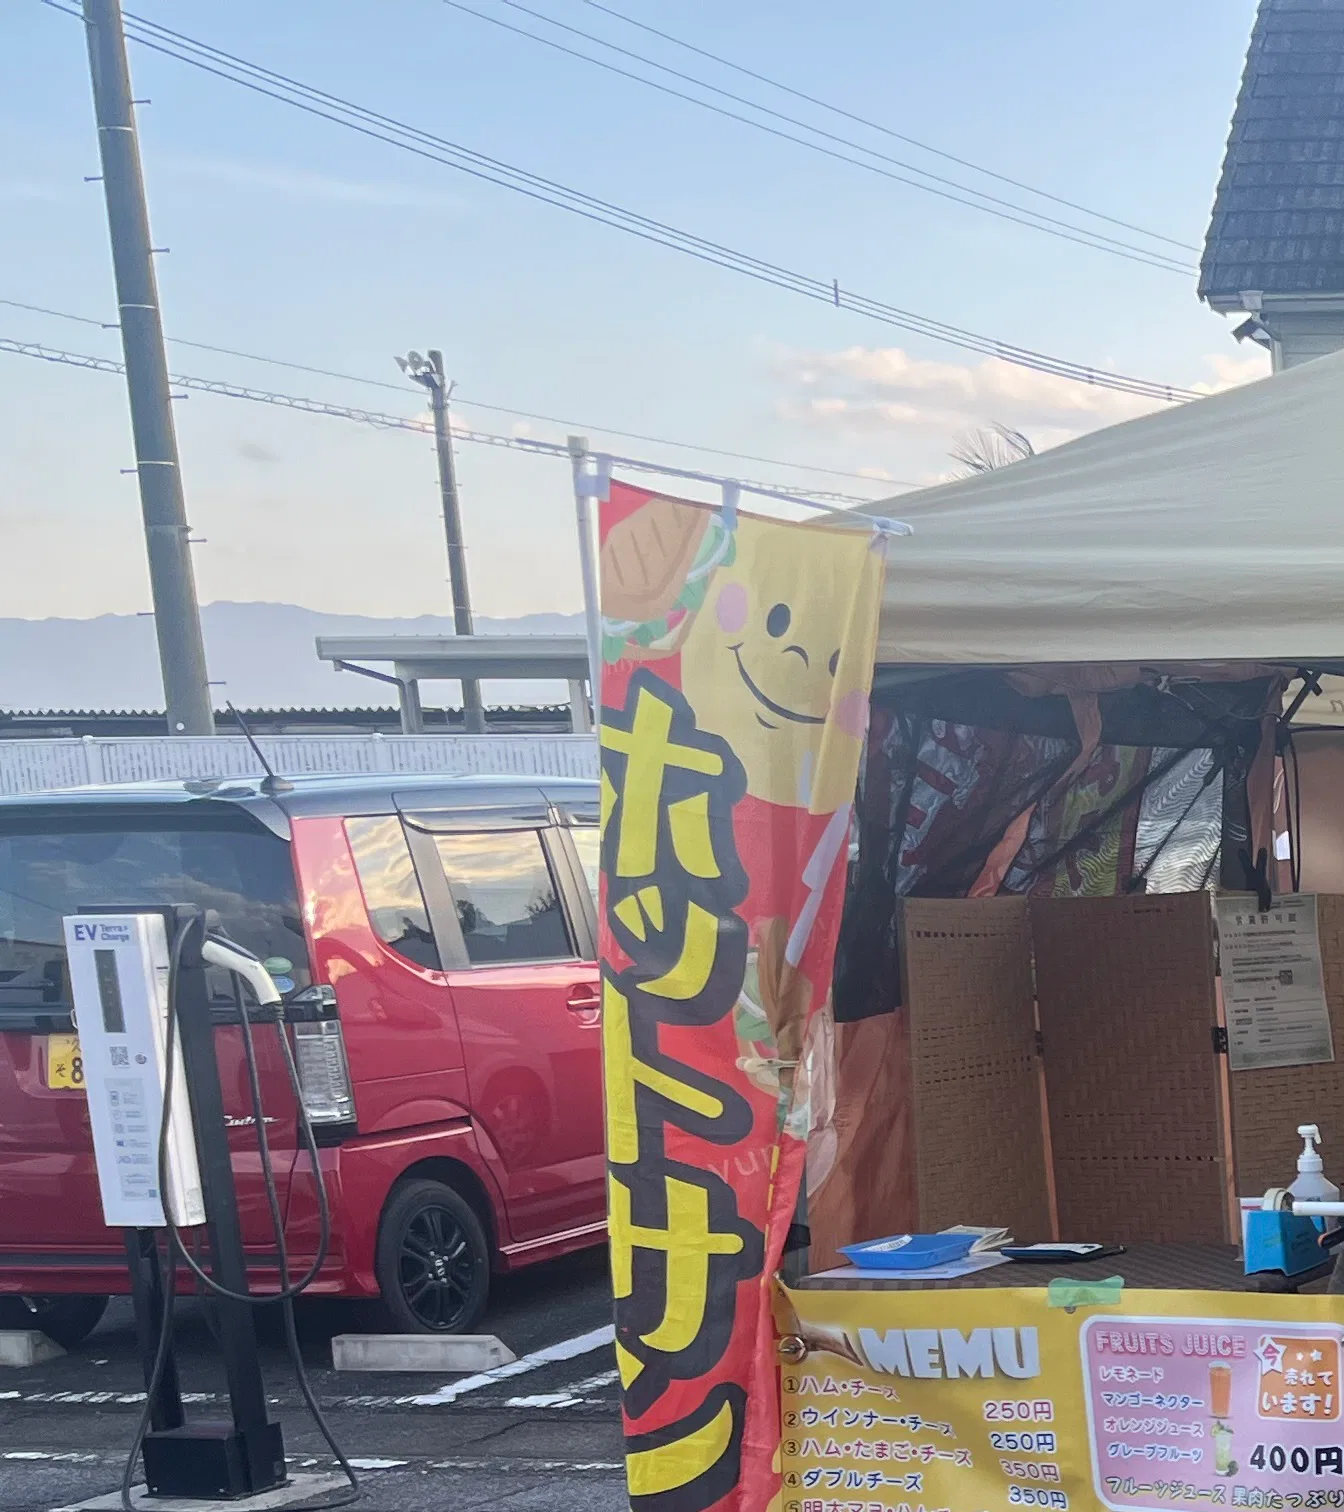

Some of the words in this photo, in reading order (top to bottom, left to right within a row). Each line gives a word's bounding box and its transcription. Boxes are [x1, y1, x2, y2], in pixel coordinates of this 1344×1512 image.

[74, 924, 97, 941] EV
[857, 1325, 1041, 1379] MEMU
[1094, 1330, 1175, 1357] FRUITS
[1183, 1333, 1247, 1359] JUICE
[1262, 1346, 1281, 1367] 今
[1100, 1366, 1164, 1384] レモネード
[1284, 1369, 1334, 1387] 売れて
[985, 1402, 1053, 1422] 250円
[1102, 1392, 1204, 1411] マンゴーネクター
[1262, 1392, 1334, 1415] います!
[1105, 1418, 1204, 1437] オレンジジュース
[991, 1432, 1056, 1453] 250円
[1108, 1444, 1204, 1461] グレープフルーツ
[802, 1439, 973, 1467] ハム・たまご・チーズ
[1001, 1459, 1060, 1482] 350円
[1250, 1444, 1344, 1476] 400円
[803, 1469, 922, 1492] ダブルチーズ
[1010, 1486, 1067, 1509] 350円
[1106, 1476, 1227, 1503] フルーツジュース
